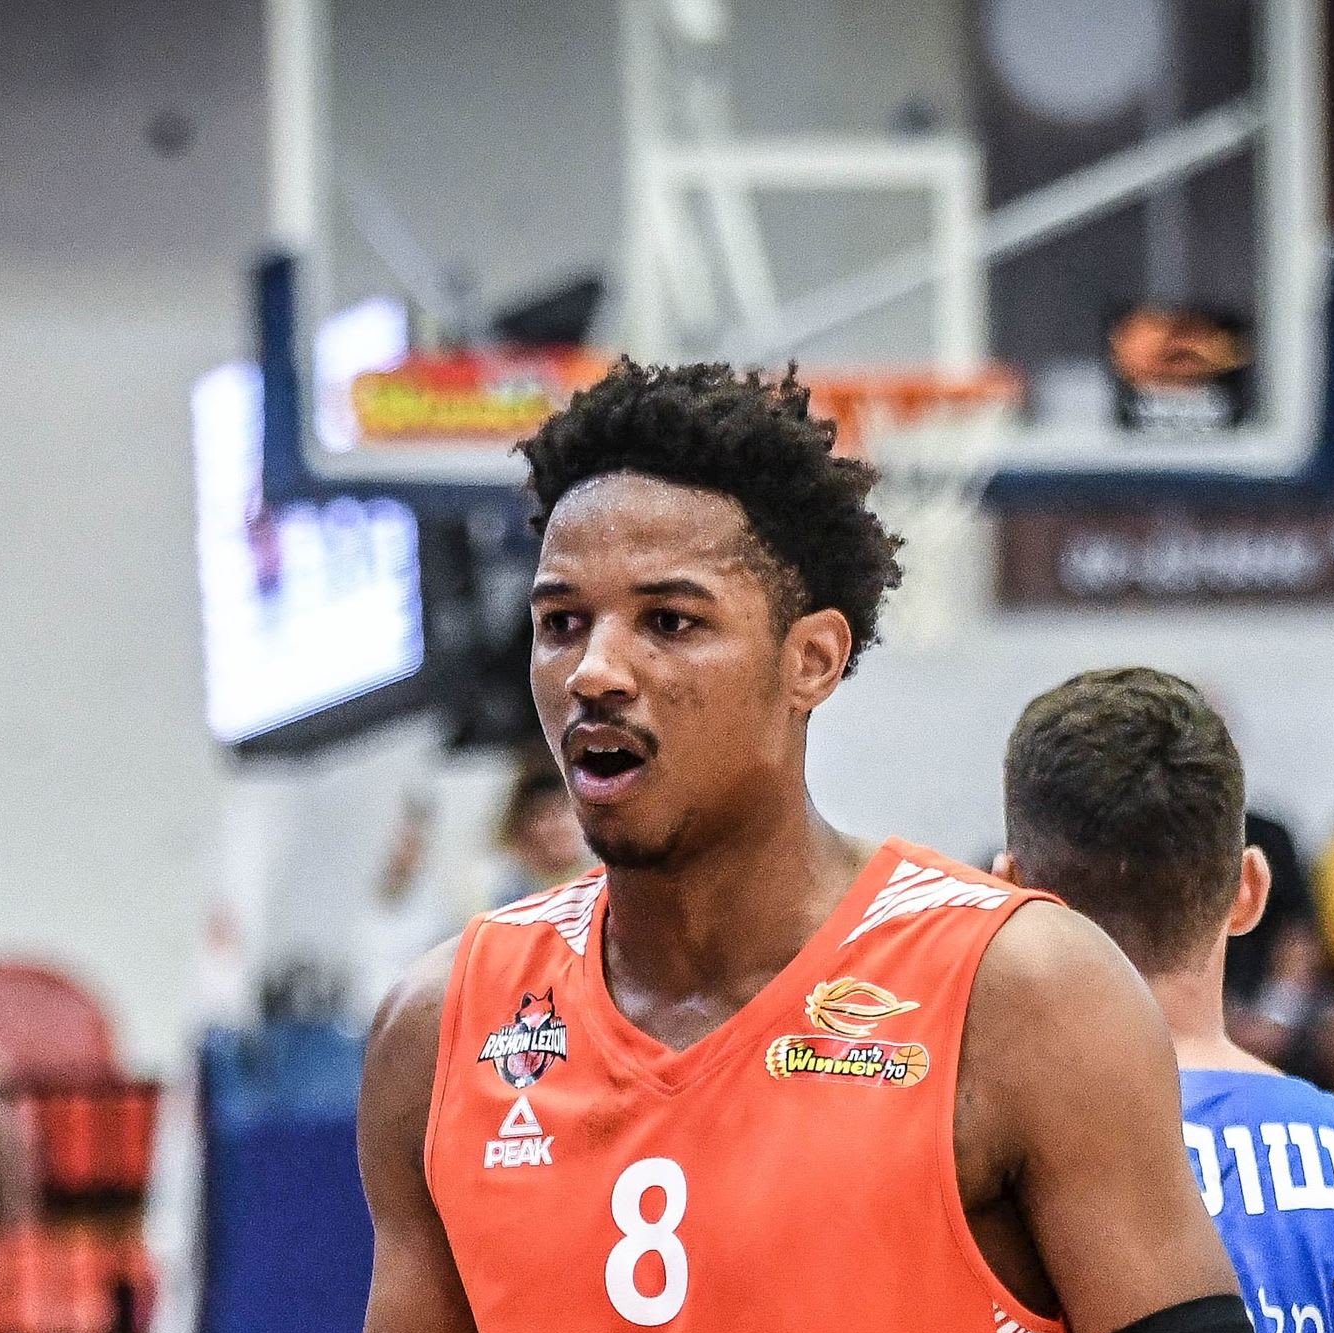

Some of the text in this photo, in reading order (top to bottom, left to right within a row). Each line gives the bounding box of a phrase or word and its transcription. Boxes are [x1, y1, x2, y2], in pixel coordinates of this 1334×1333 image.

[480, 1031, 530, 1060] RISHON
[787, 1047, 883, 1077] Winner
[884, 1061, 907, 1079] סל
[483, 1135, 555, 1169] PEAK
[604, 1156, 690, 1328] 8
